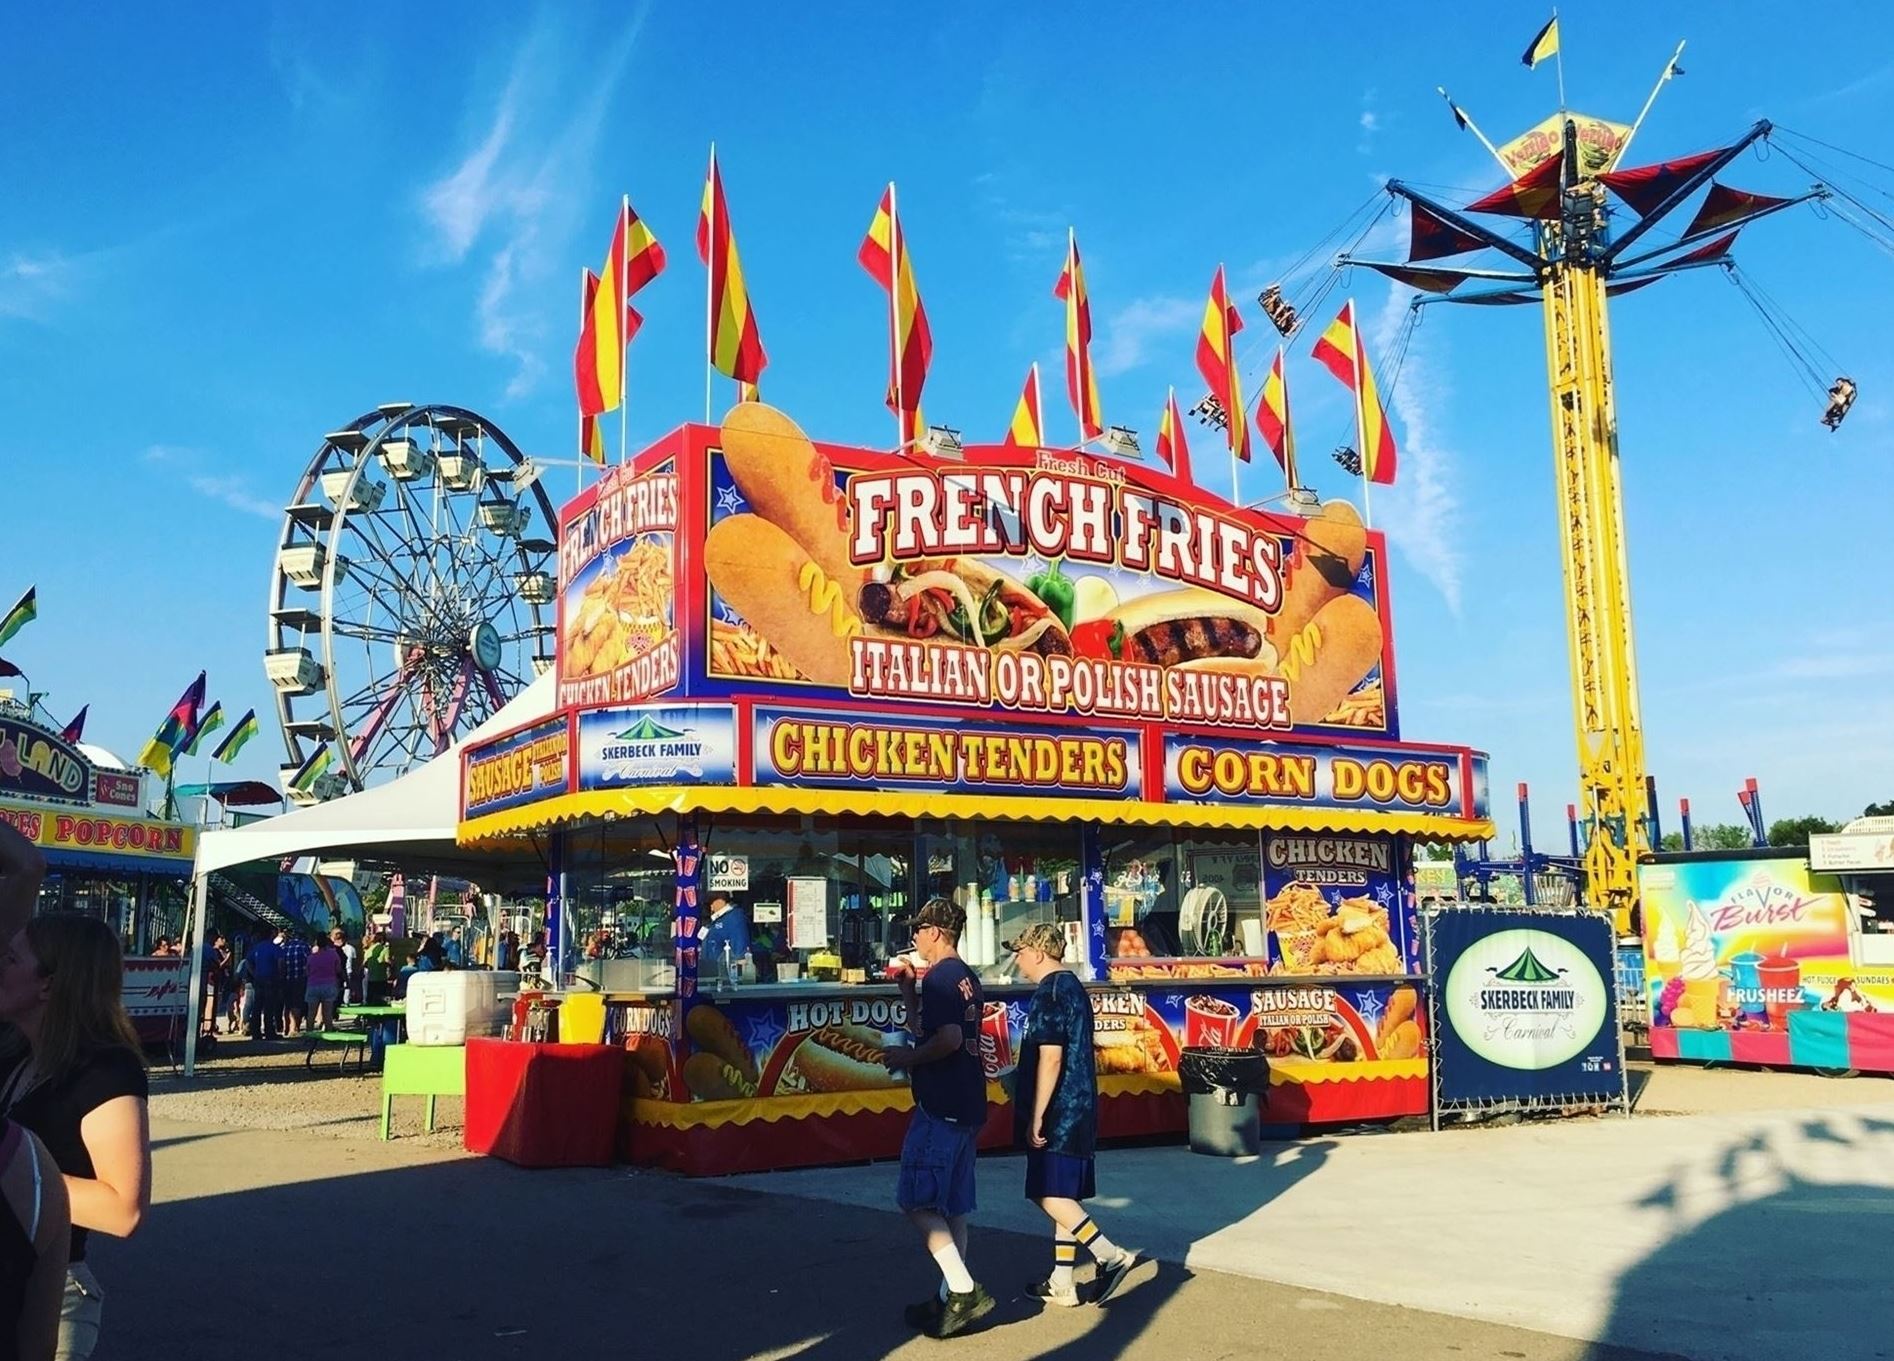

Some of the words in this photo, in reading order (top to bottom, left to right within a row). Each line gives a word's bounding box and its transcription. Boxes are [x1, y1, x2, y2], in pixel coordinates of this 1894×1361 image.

[1037, 450, 1089, 476] Fresh
[1094, 461, 1127, 483] Cut
[560, 488, 623, 592] FRENCH
[625, 473, 680, 534] FRIES
[852, 469, 1113, 563] FRENCH
[1123, 490, 1284, 611] FRIES
[615, 633, 680, 703] TENDERS
[852, 639, 990, 701] ITALIAN
[997, 651, 1046, 706] OR
[1052, 657, 1163, 718] POLISH
[1167, 668, 1292, 730] SAUSAGE
[16, 732, 83, 793] LAND
[602, 746, 655, 760] SKERBECK
[660, 742, 701, 757] FAMILY
[773, 719, 957, 780] CHICKEN
[960, 732, 1127, 788] TENDERS
[116, 780, 134, 791] Sno
[469, 744, 533, 807] SAUSAGE
[1179, 747, 1316, 797] CORN
[1332, 759, 1450, 805] DOGS
[56, 816, 183, 853] POPCORN
[709, 860, 729, 874] NO
[1268, 838, 1391, 871] CHICKEN
[709, 878, 747, 888] SMOKING
[1296, 869, 1368, 885] TENDERS
[1710, 895, 1828, 933] Burst
[1727, 988, 1805, 1004] FRUSHEEZ
[1802, 977, 1816, 985] HOT
[1856, 976, 1890, 985] SUNDAES
[1089, 992, 1145, 1017] CKEN
[1252, 988, 1335, 1013] SAUSAGE
[1480, 990, 1539, 1010] SKERBECK
[1541, 990, 1575, 1010] FAMILY
[613, 1006, 640, 1035] CORN
[642, 1007, 671, 1038] DOGS
[788, 1002, 845, 1033] HOT
[1094, 1019, 1126, 1031] DERS
[1258, 1014, 1289, 1026] ITALIAN
[1291, 1015, 1301, 1025] OR
[1302, 1014, 1330, 1026] POLISH
[1503, 1014, 1559, 1040] Carnival
